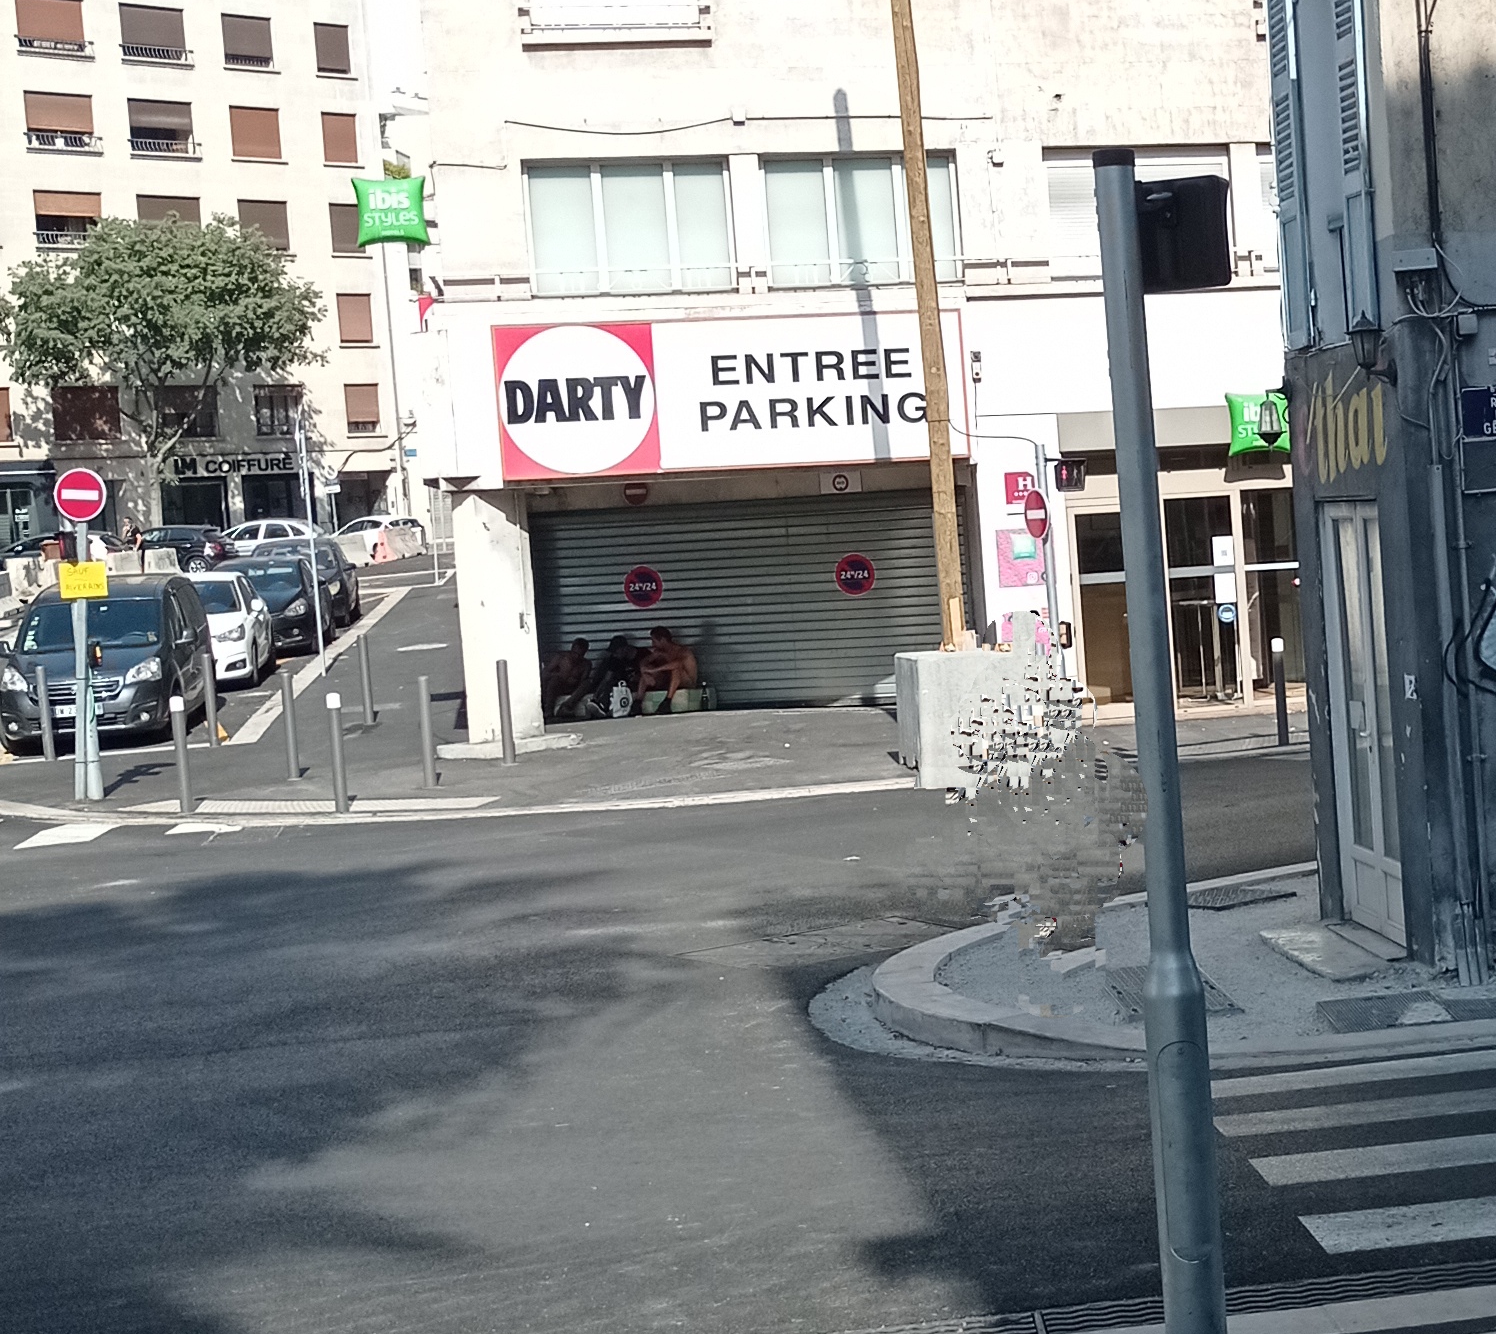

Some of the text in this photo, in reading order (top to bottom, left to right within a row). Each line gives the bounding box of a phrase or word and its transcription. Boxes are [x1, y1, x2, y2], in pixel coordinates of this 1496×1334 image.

[368, 188, 411, 210] ibis
[710, 347, 913, 386] ENTREE
[504, 374, 647, 425] DARTY
[700, 392, 929, 433] PARKING
[205, 457, 294, 474] COIFFURE
[1017, 477, 1032, 490] H
